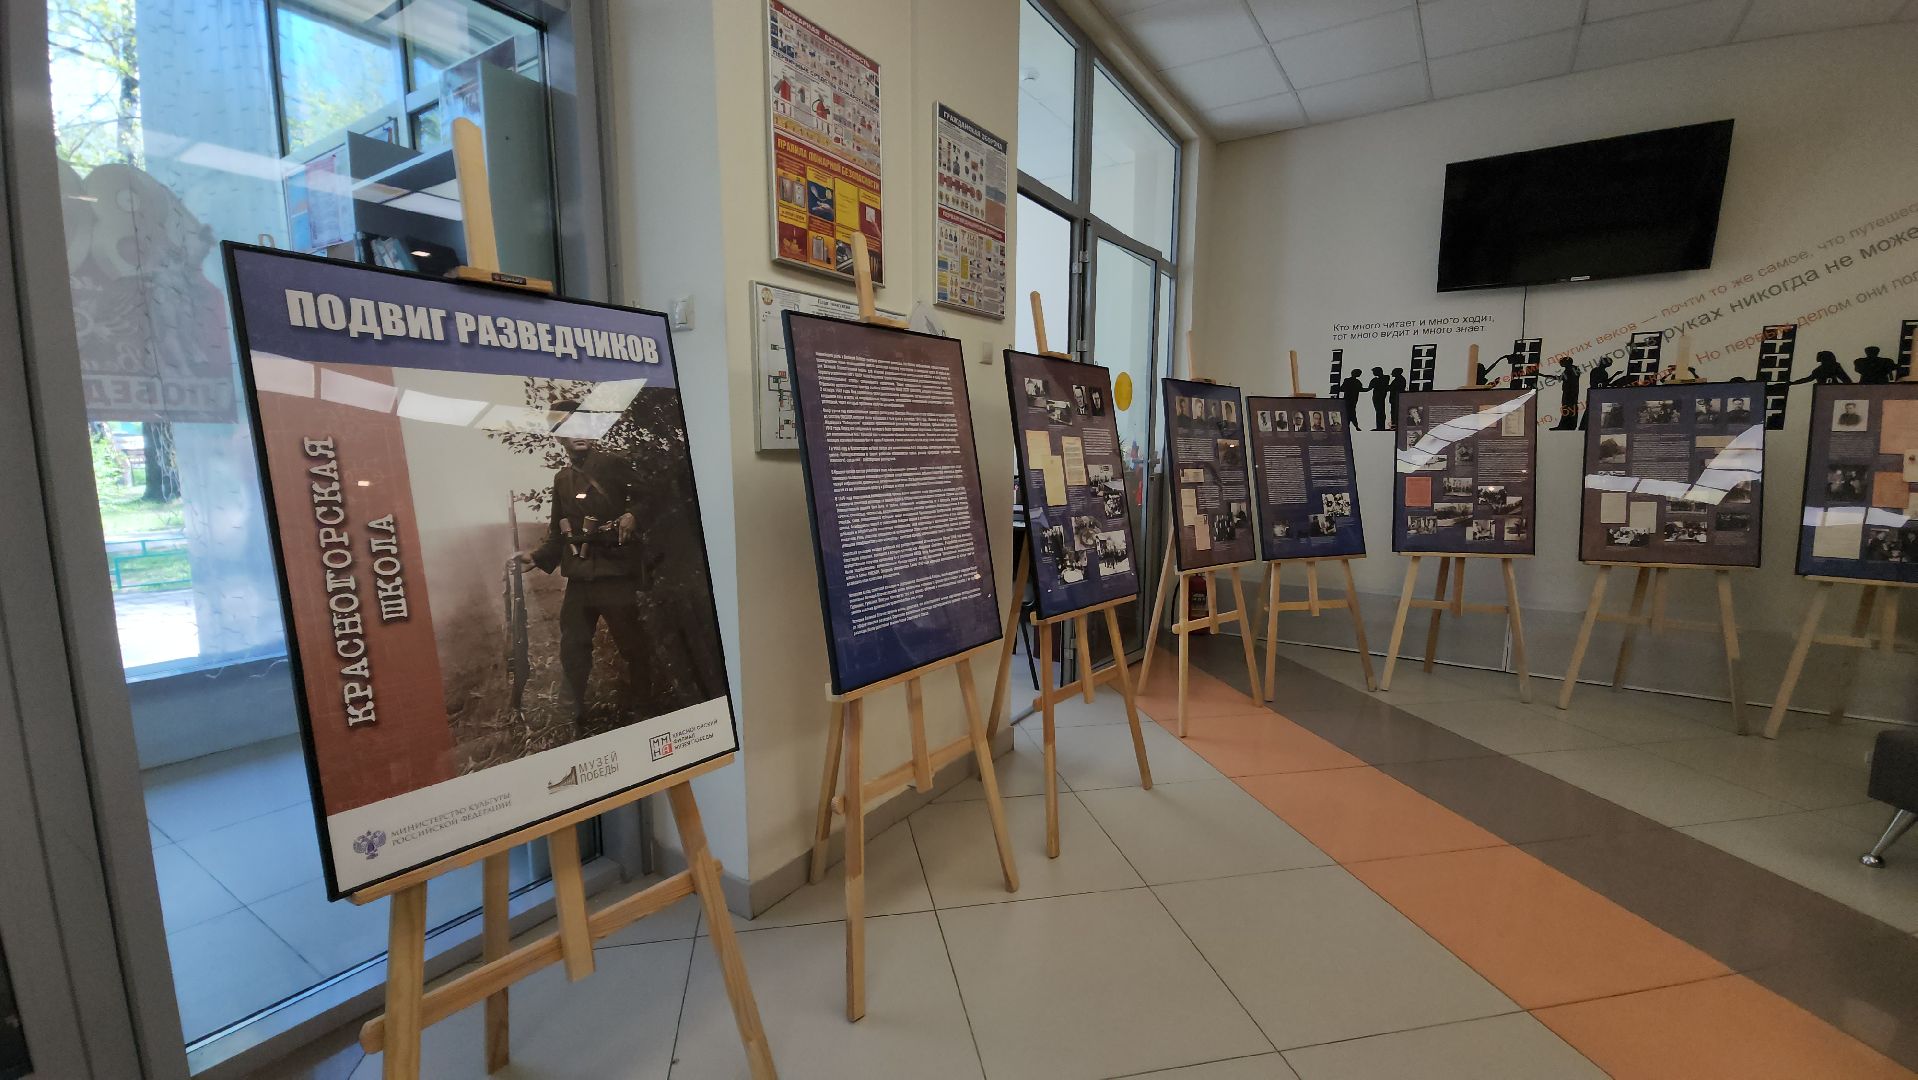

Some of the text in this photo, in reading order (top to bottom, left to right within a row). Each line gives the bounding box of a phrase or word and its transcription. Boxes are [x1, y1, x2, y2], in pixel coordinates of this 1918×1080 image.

[284, 288, 660, 366] ПОДВИГ РАЗВЕДЧИКОВ
[1333, 323, 1350, 332] Кто
[1352, 322, 1381, 331] много
[1383, 319, 1416, 329] читает
[1428, 316, 1460, 326] много
[1333, 333, 1348, 341] тот
[1350, 331, 1378, 340] много
[1381, 329, 1411, 339] видит
[1422, 327, 1453, 336] много
[1547, 341, 1592, 368] других
[1596, 322, 1638, 345] веков
[1661, 293, 1705, 317] почти
[1710, 284, 1728, 297] то
[1732, 273, 1754, 289] же
[1817, 234, 1846, 250] что
[1663, 307, 1724, 345] руках
[1729, 268, 1820, 313] никогда
[1825, 254, 1854, 275] не
[1695, 348, 1721, 365] Но
[1797, 298, 1852, 328] делом
[1856, 284, 1889, 304] они
[304, 435, 376, 728] КРАСНОГОРСКАЯ
[368, 513, 409, 622] ШКОЛА
[578, 750, 618, 773] МУЗЕЙ
[579, 763, 619, 784] ПОБЕДЫ
[390, 807, 467, 837] МИНИСТЕРСТВО
